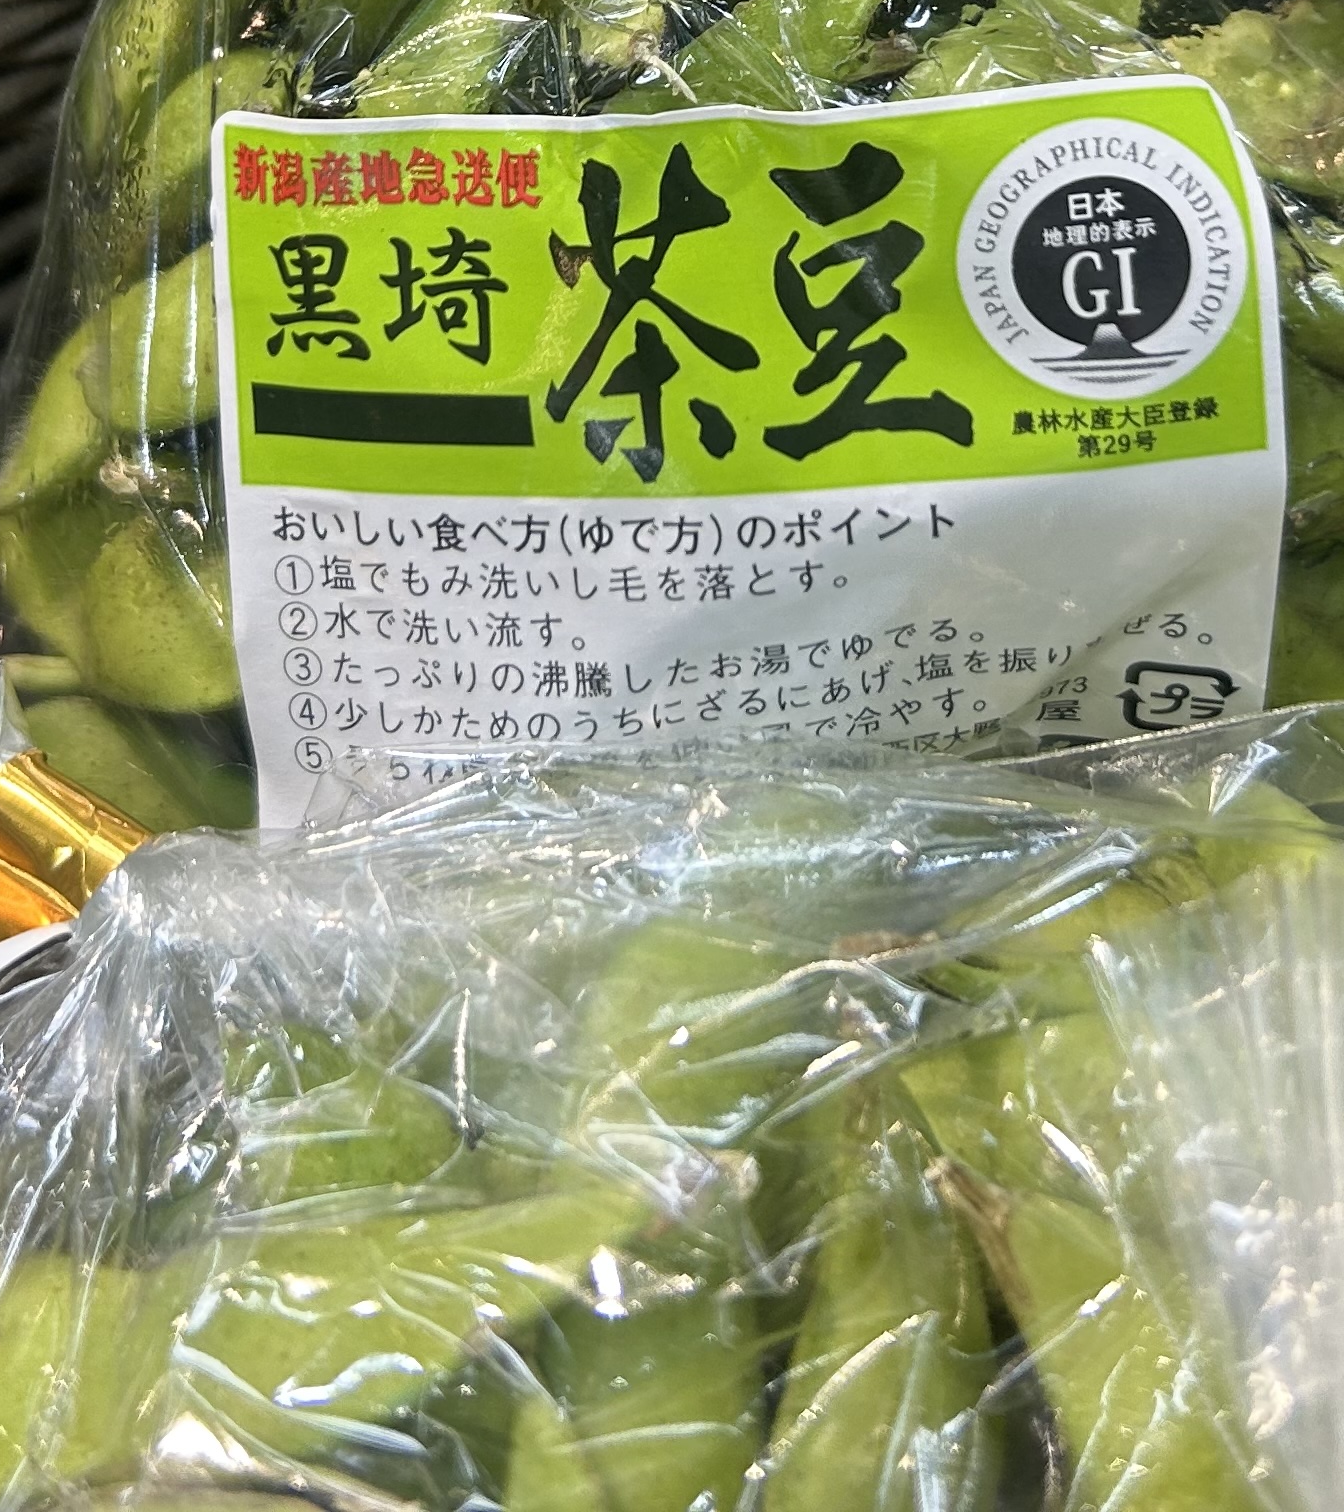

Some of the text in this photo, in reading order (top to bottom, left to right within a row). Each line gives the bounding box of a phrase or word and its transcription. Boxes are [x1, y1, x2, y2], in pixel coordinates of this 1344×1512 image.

[233, 141, 544, 209] 新潟産地急送便
[1067, 187, 1127, 222] 日本
[974, 135, 1233, 346] JAPAN GEOGRAPHICAL INDICATION
[1042, 216, 1157, 249] 地理的表示
[1061, 245, 1143, 321] GI
[545, 141, 974, 484] 茶豆
[1011, 396, 1220, 436] 農林水産大臣登録
[1077, 429, 1157, 459] 第29号
